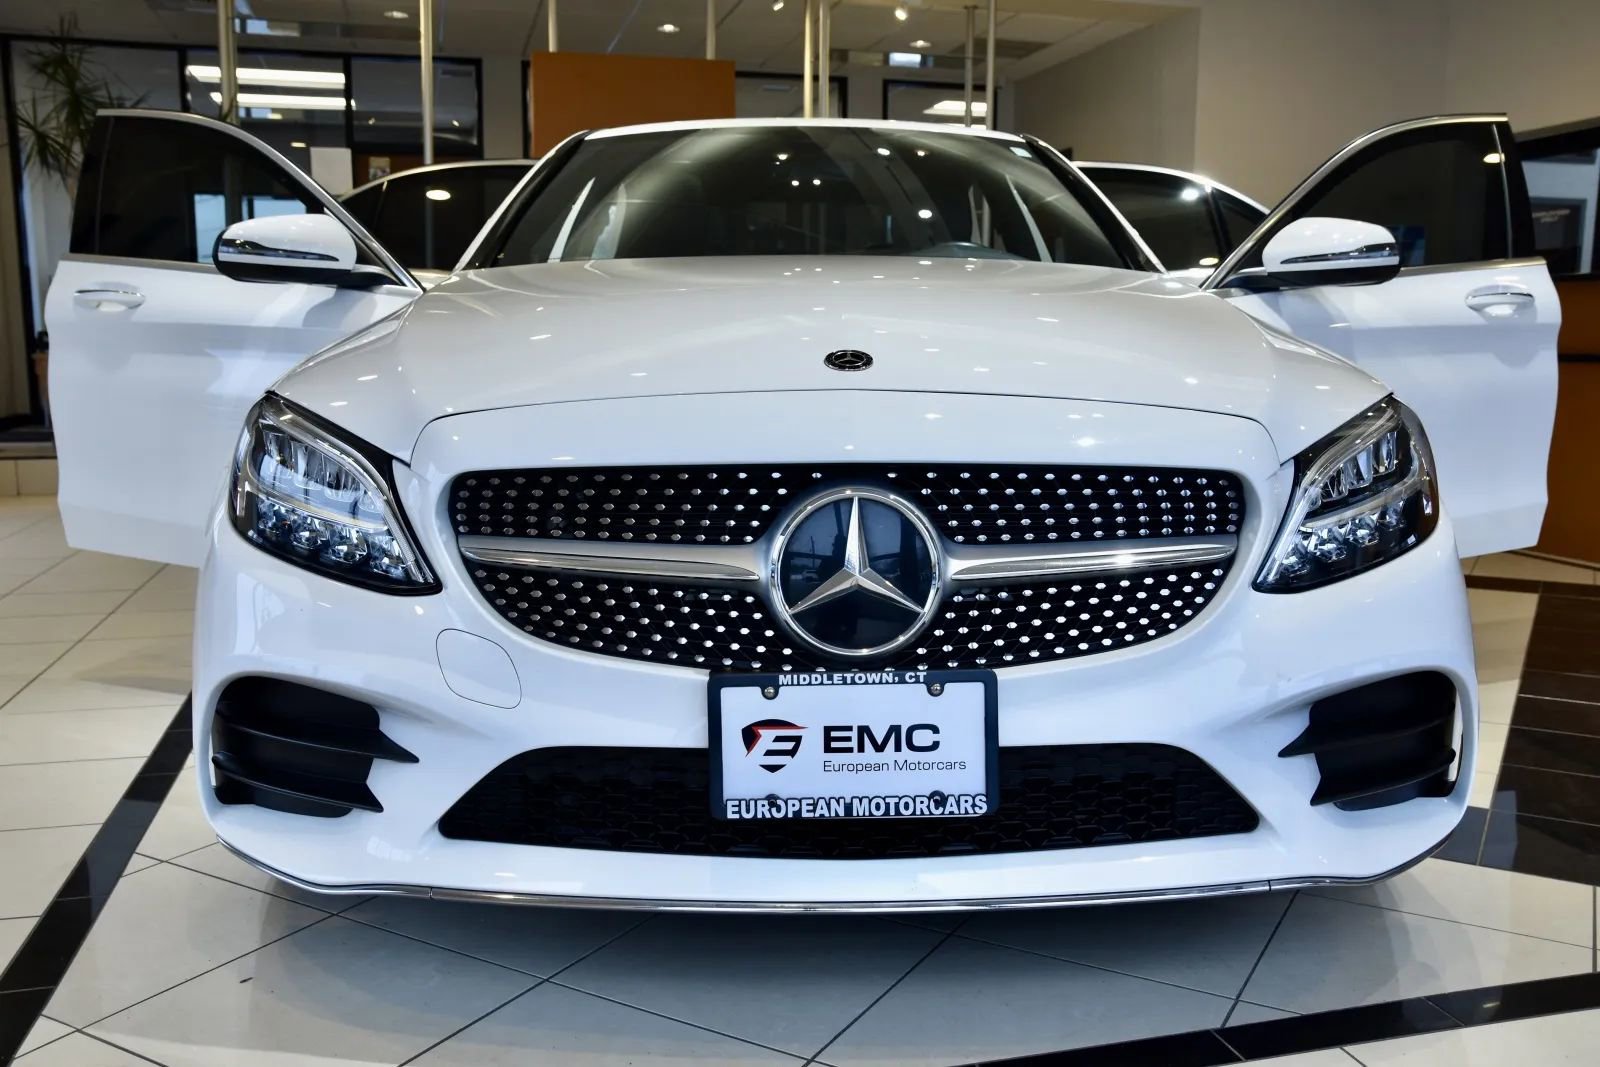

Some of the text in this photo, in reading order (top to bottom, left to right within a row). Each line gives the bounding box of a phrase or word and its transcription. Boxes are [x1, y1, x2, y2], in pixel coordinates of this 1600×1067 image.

[778, 671, 927, 685] MIDDLETOWN, CT
[823, 723, 941, 753] EMC
[823, 759, 967, 774] European Motorcars
[726, 795, 988, 819] EUROPEAN MOTORCARS
